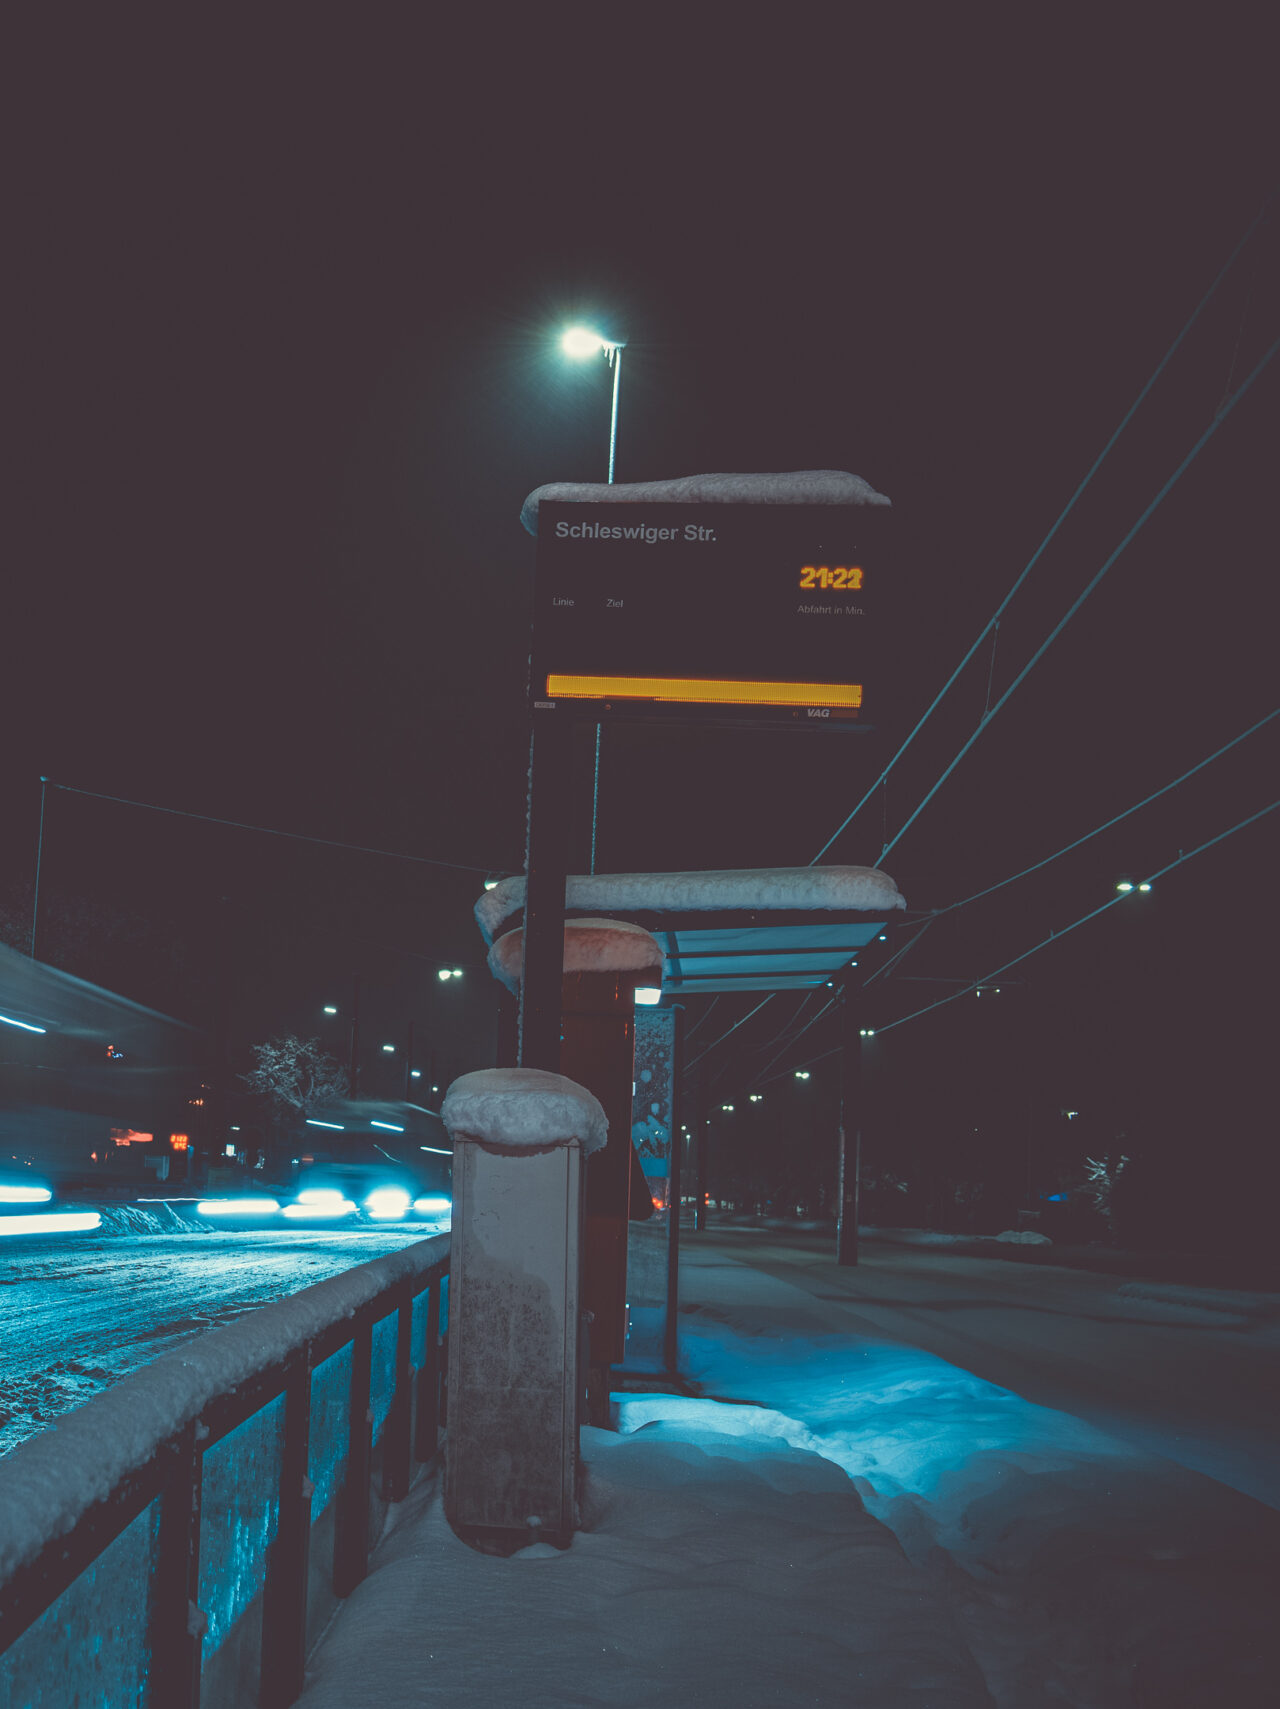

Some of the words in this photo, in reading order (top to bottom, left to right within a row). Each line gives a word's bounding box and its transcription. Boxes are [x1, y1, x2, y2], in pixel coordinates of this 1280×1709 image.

[555, 521, 679, 544] Schleswiger
[683, 524, 718, 541] Str.
[552, 597, 575, 606] Linie
[606, 598, 624, 608] Ziel
[797, 605, 831, 614] Abfahrt
[834, 605, 843, 614] in
[845, 606, 865, 615] Min.
[807, 708, 830, 718] VAG
